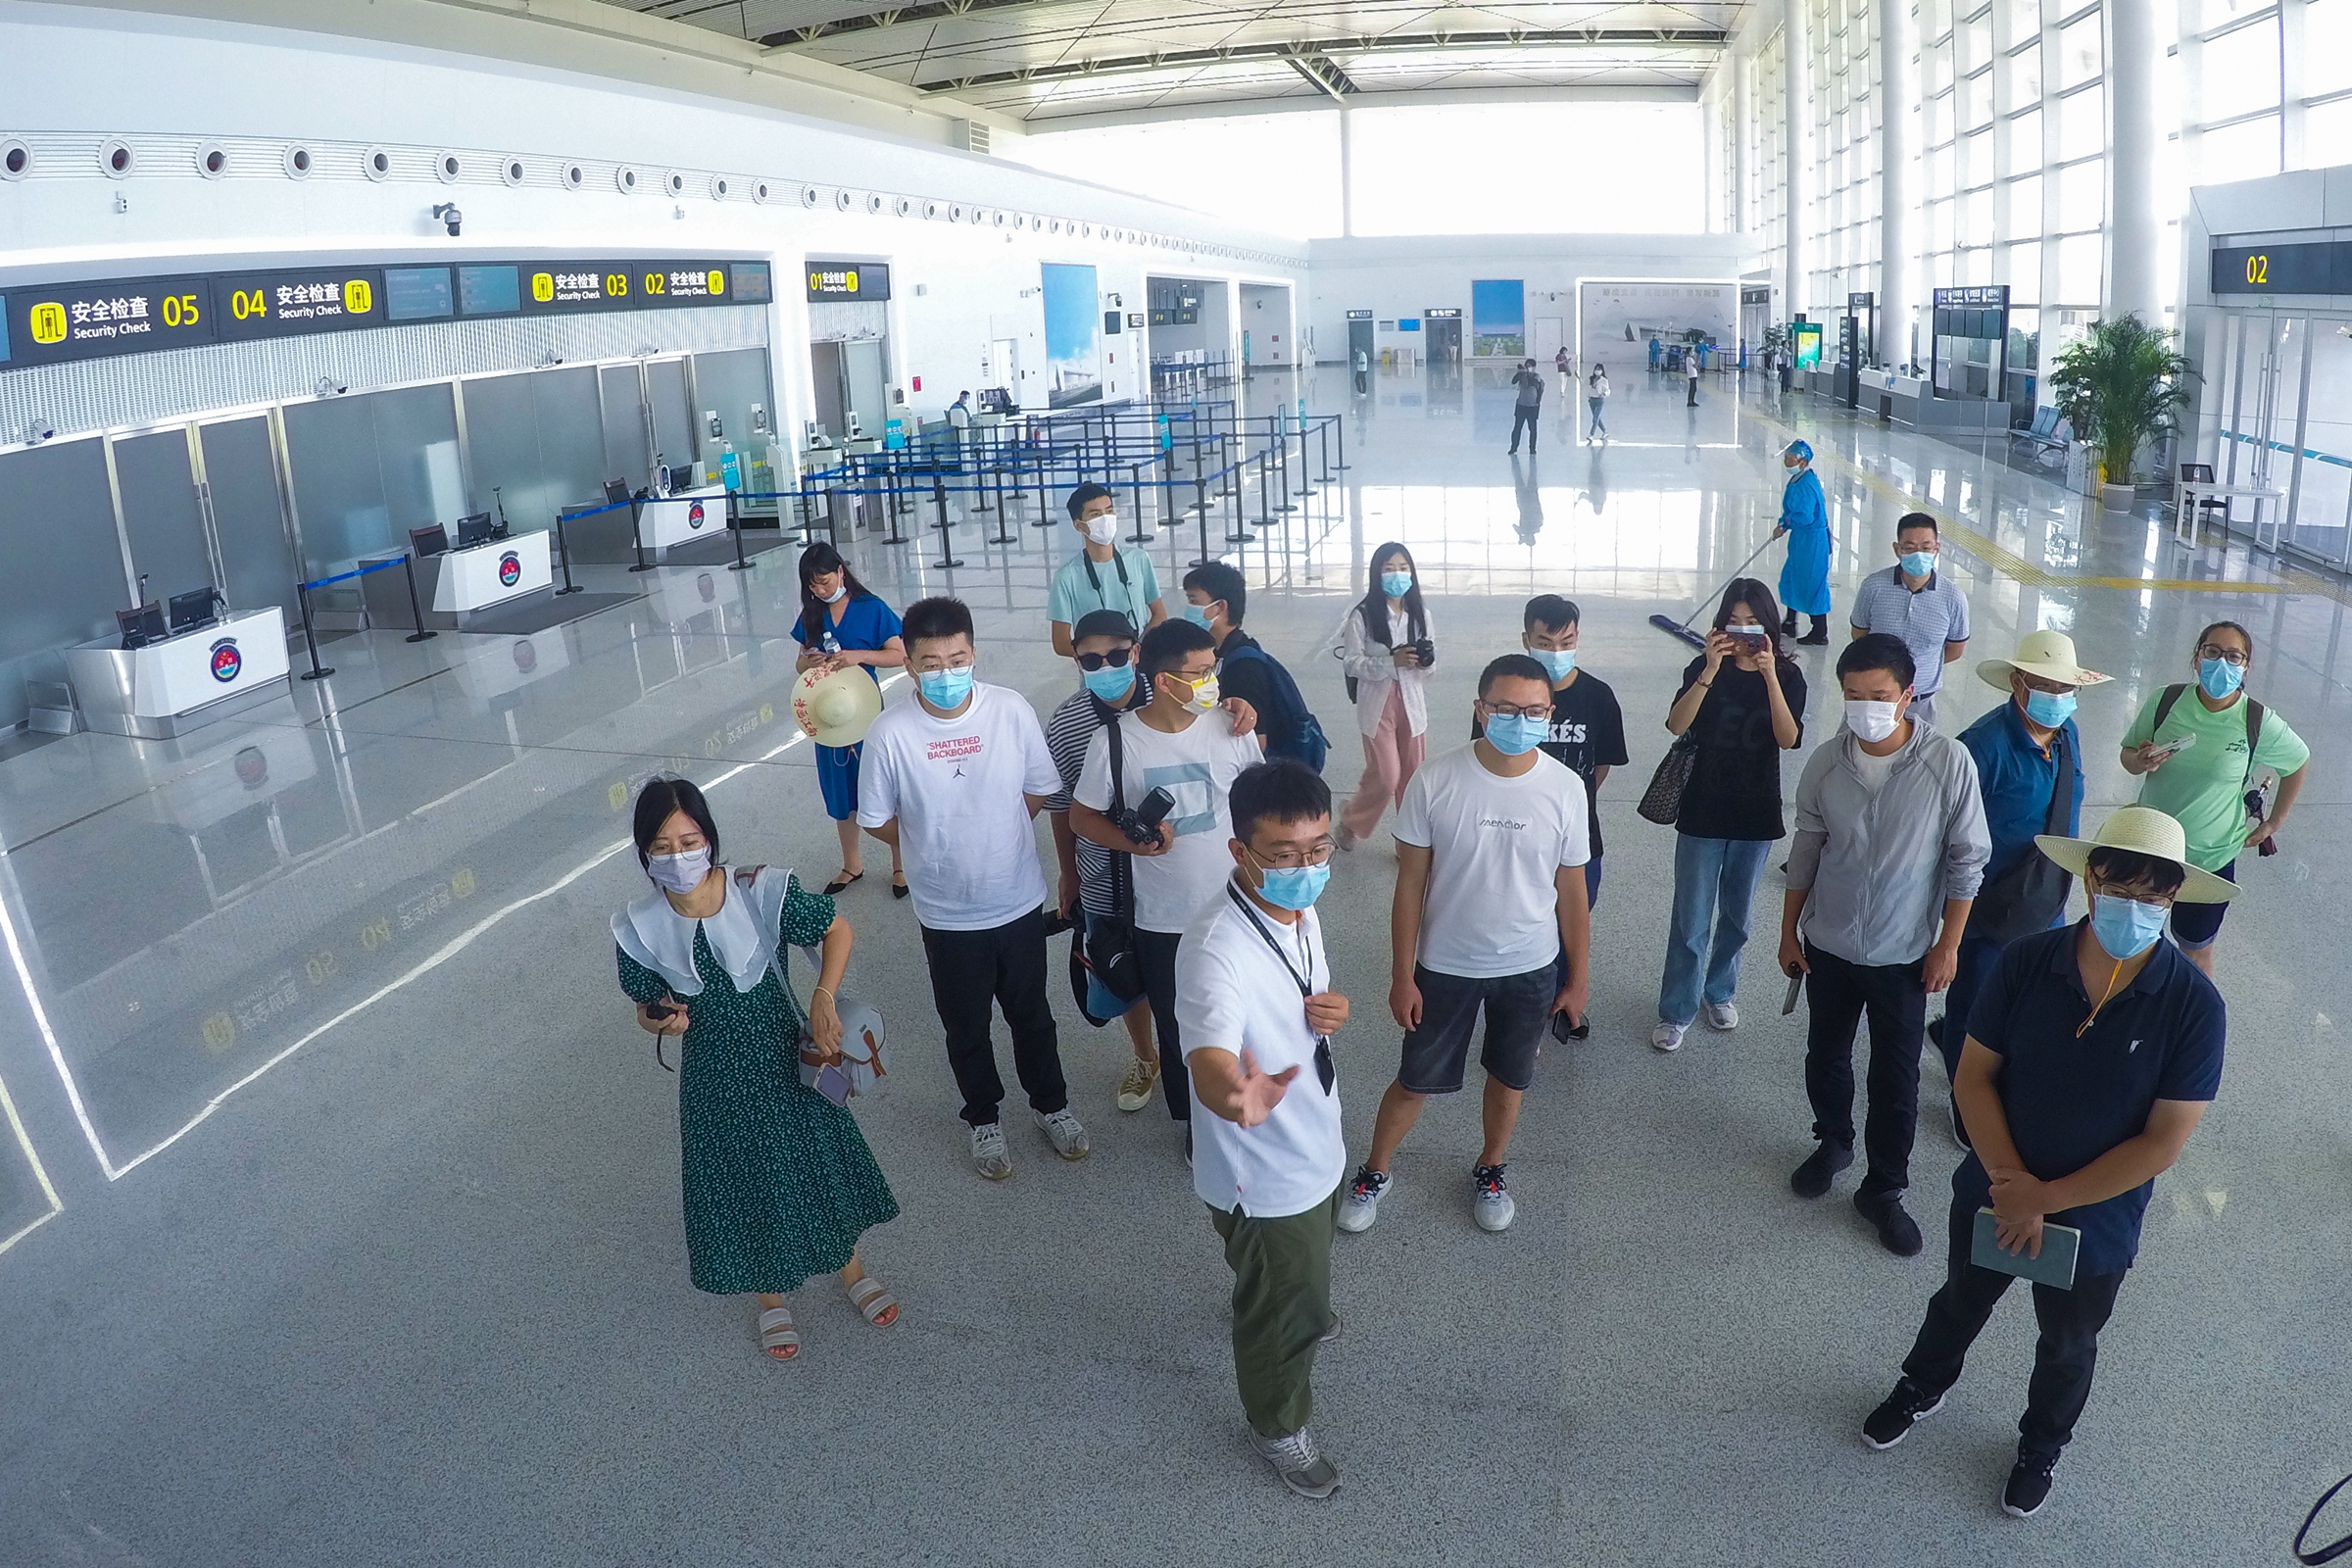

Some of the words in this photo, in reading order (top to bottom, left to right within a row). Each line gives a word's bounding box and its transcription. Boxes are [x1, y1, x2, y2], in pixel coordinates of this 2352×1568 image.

[822, 271, 846, 284] 安全检查
[2246, 255, 2268, 283] 02
[555, 273, 600, 289] 安全检查
[607, 273, 627, 297] 03
[645, 273, 665, 295] 02
[670, 271, 706, 286] 安全检查
[810, 272, 822, 290] 01
[276, 282, 341, 306] 安全检查
[557, 291, 581, 301] Security
[582, 290, 601, 300] Check
[671, 287, 692, 297] Security
[72, 296, 150, 324] 安全检查
[162, 294, 199, 326] 05
[231, 289, 268, 320] 04
[278, 307, 315, 319] Security
[316, 305, 342, 317] Check
[74, 324, 119, 340] Security
[119, 321, 152, 335] Check
[926, 736, 981, 751] "SHATTERED
[927, 744, 984, 760] BACKBOARD"
